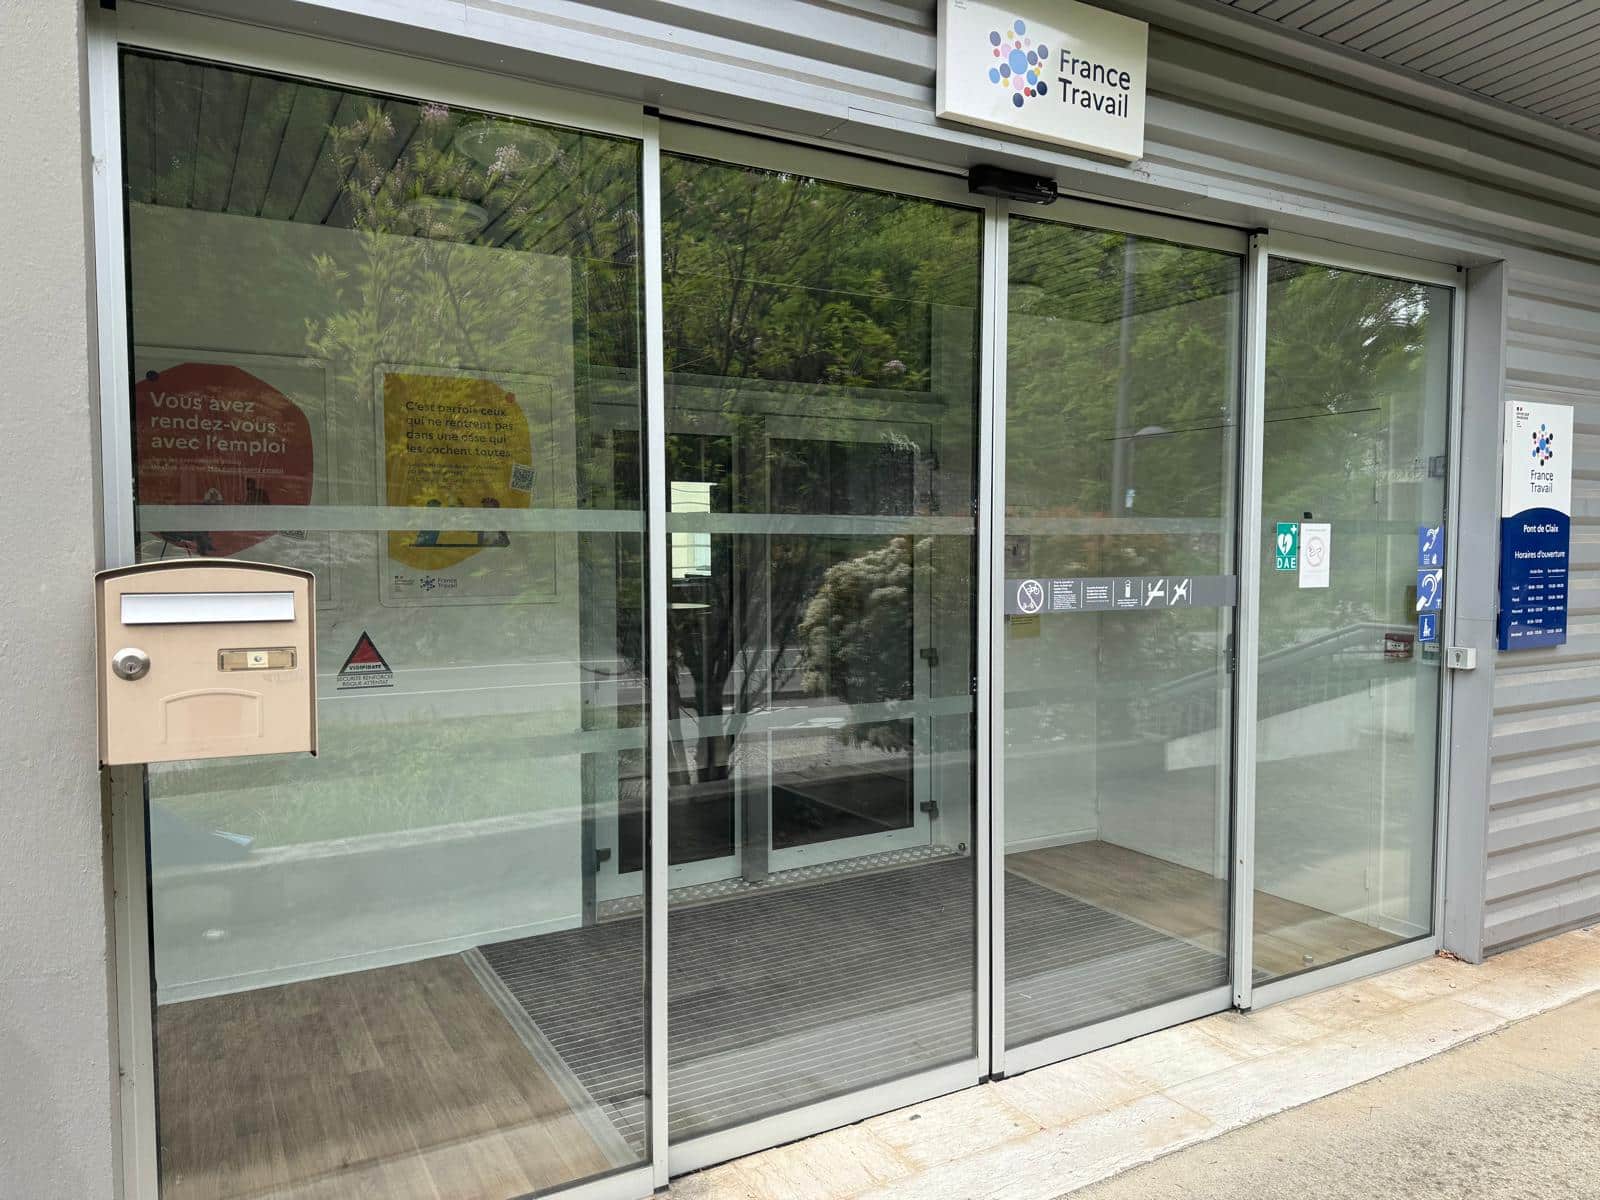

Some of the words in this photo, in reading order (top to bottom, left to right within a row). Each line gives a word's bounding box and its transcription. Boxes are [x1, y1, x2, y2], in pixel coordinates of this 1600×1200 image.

[1059, 48, 1131, 91] France
[1058, 77, 1129, 118] Travail
[150, 392, 202, 410] Vous
[209, 399, 256, 414] avez
[405, 400, 438, 412] C'est
[480, 407, 507, 417] ceux
[150, 415, 278, 434] rendez-vous
[406, 416, 425, 428] qui
[427, 418, 442, 427] ne
[445, 418, 492, 430] rentrent
[495, 422, 514, 433] pas
[406, 428, 434, 441] dans
[436, 431, 459, 442] une
[488, 433, 507, 446] qui
[151, 436, 200, 451] avec
[206, 435, 287, 457] l'emploi
[406, 442, 423, 453] les
[1530, 469, 1554, 481] France
[1530, 482, 1553, 493] Travail
[1523, 524, 1537, 533] Pont
[1537, 523, 1545, 533] de
[1545, 523, 1559, 533] Claix
[1276, 557, 1297, 569] DAE
[1514, 550, 1537, 560] Horaires
[1537, 550, 1566, 559] d'ouverture
